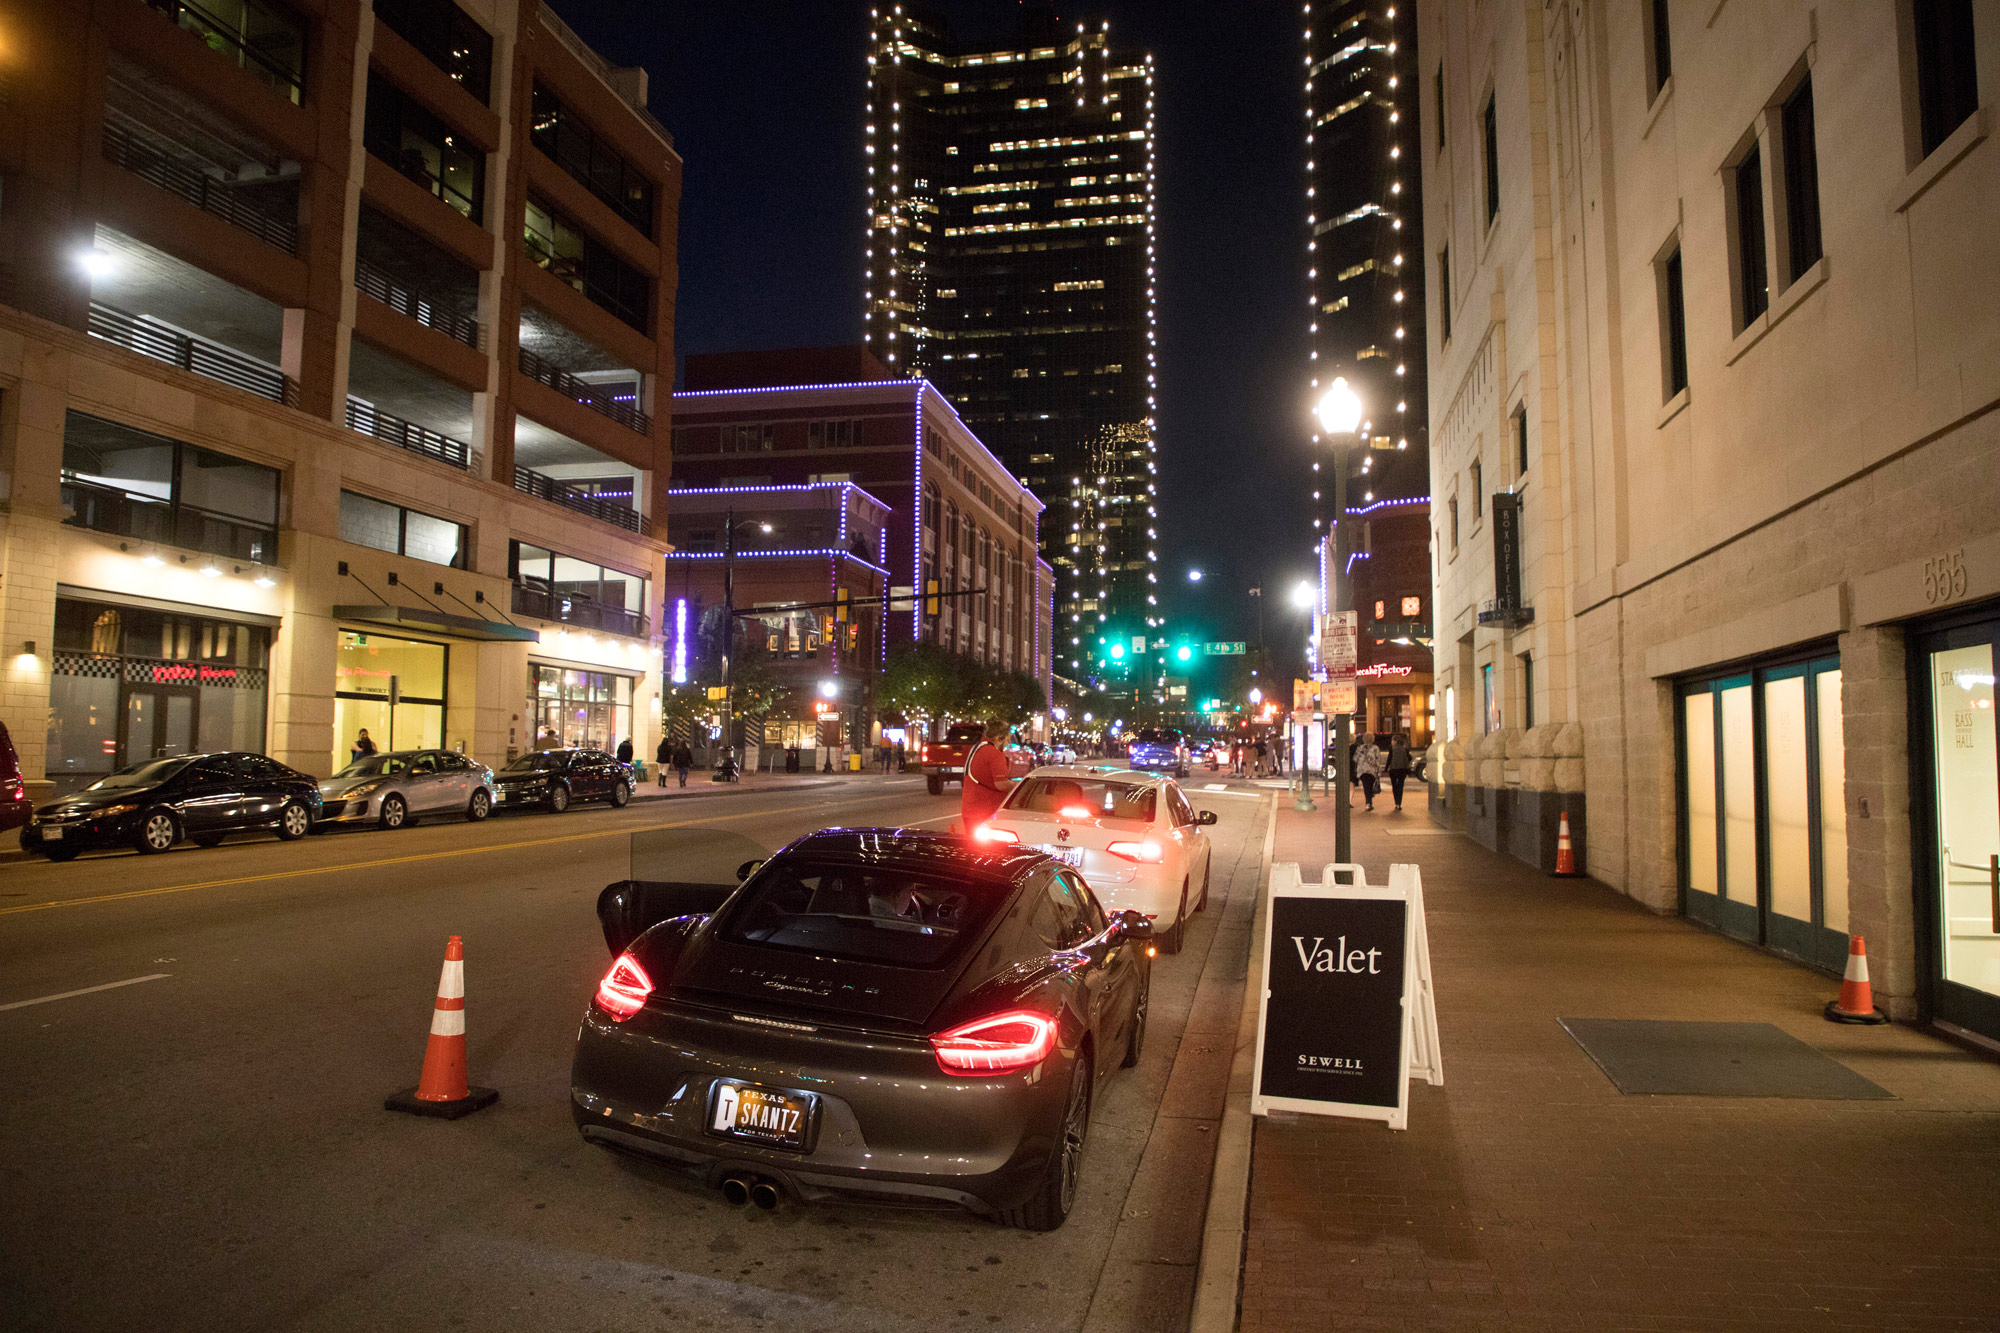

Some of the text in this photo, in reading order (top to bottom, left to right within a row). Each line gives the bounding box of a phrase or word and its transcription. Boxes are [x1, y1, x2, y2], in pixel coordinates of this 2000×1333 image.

[1502, 510, 1510, 540] BOX
[1924, 547, 1968, 605] 555
[1206, 643, 1243, 652] E 4th St
[1373, 663, 1412, 679] Factory
[1955, 713, 1973, 728] BASS
[1955, 734, 1974, 749] HALL
[1291, 935, 1382, 975] Valet
[1298, 1054, 1364, 1070] SEWELL
[743, 1089, 787, 1104] TEXAS
[724, 1099, 800, 1134] T SKANTZ
[758, 1131, 778, 1139] TEXAS
